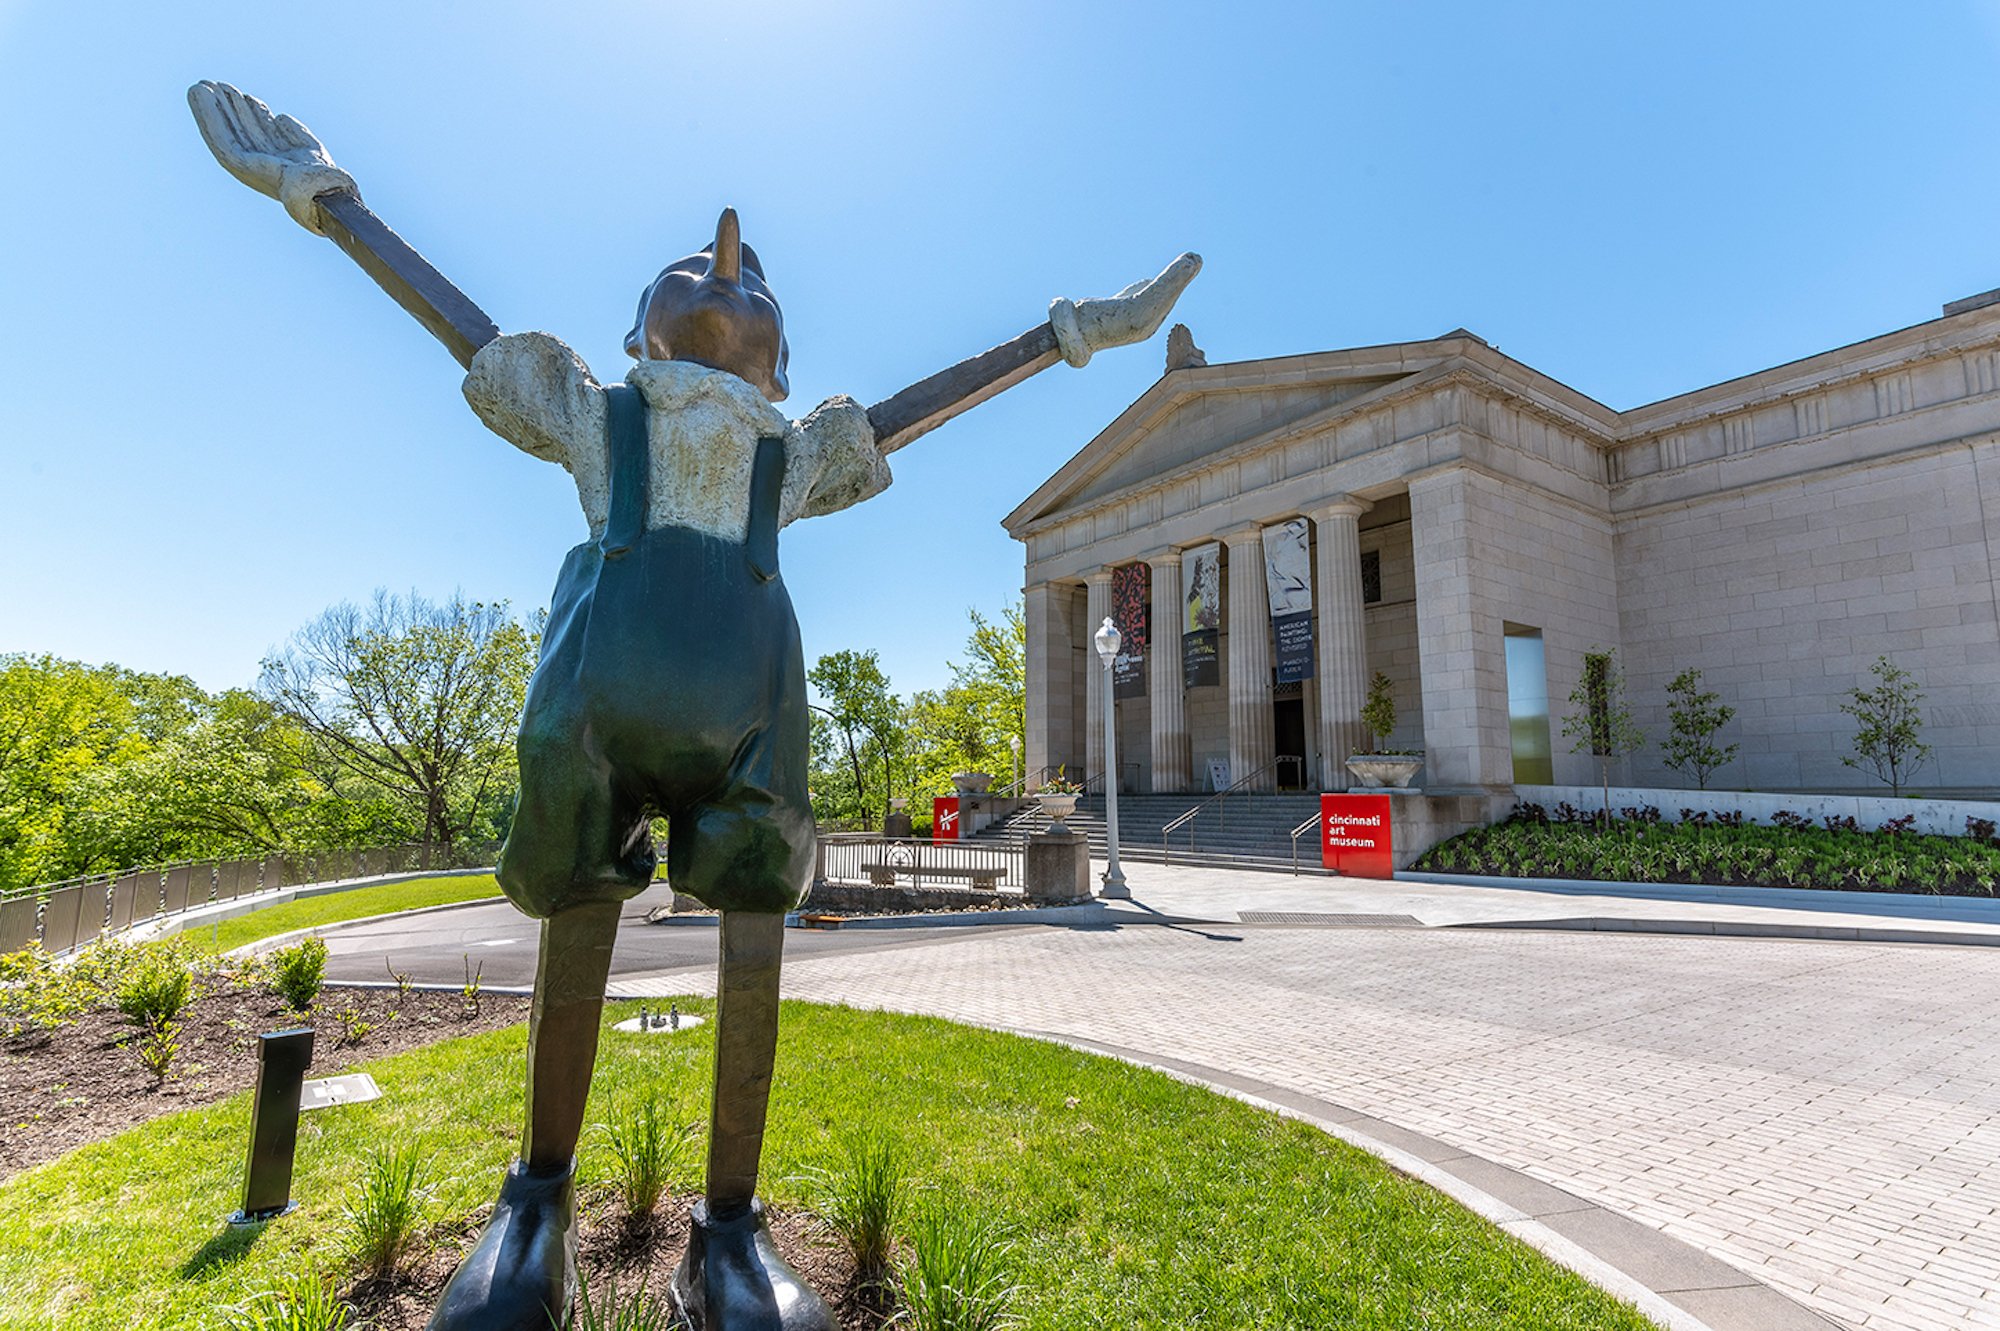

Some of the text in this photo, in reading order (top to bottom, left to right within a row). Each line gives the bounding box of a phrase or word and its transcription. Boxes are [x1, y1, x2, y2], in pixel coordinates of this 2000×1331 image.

[1328, 813, 1380, 826] cincinnati
[1329, 826, 1346, 836] art
[1329, 837, 1375, 848] museum
